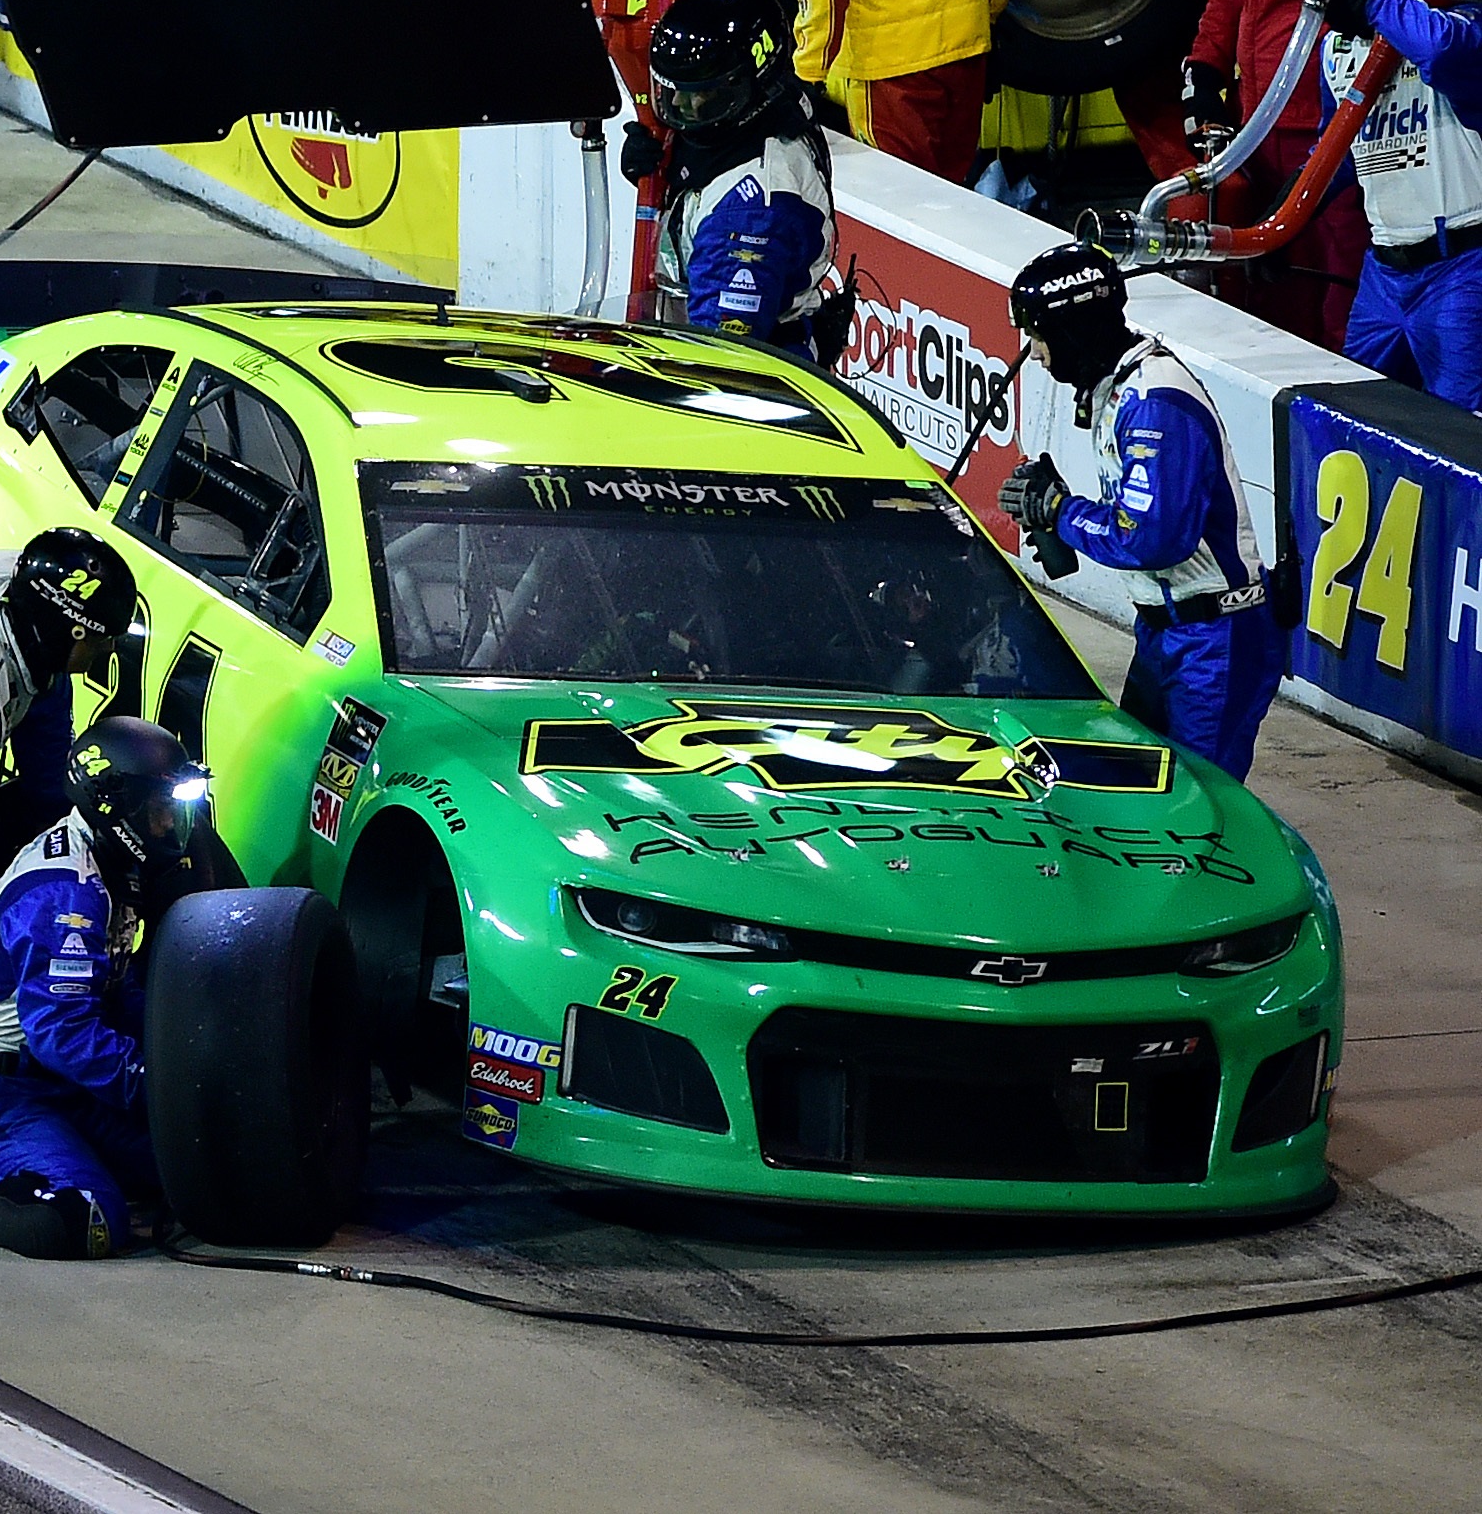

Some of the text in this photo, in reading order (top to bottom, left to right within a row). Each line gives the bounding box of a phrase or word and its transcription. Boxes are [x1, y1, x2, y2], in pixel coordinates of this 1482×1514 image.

[751, 29, 775, 69] 24
[1405, 132, 1428, 146] INC
[1039, 267, 1105, 296] AXALTA
[724, 295, 757, 307] SIEMENS
[585, 478, 791, 508] MONSTER
[644, 505, 754, 516] ENERGY
[1306, 449, 1424, 671] 24
[60, 569, 102, 600] 24
[62, 605, 106, 634] AXALTA
[76, 744, 112, 777] 24
[637, 718, 1018, 783] City
[312, 788, 342, 843] 3M
[385, 771, 468, 835] GOODYEAR
[112, 825, 147, 863] AXALTA
[604, 804, 1227, 852] HENDRICK
[629, 824, 1256, 886] AUTOGUARD
[54, 963, 87, 972] SIEMENS
[599, 965, 678, 1019] 24
[468, 1027, 560, 1067] MOOG
[1137, 1036, 1199, 1060] ZL1
[470, 1060, 536, 1094] Edelbrock
[466, 1110, 516, 1133] SUNOCO
